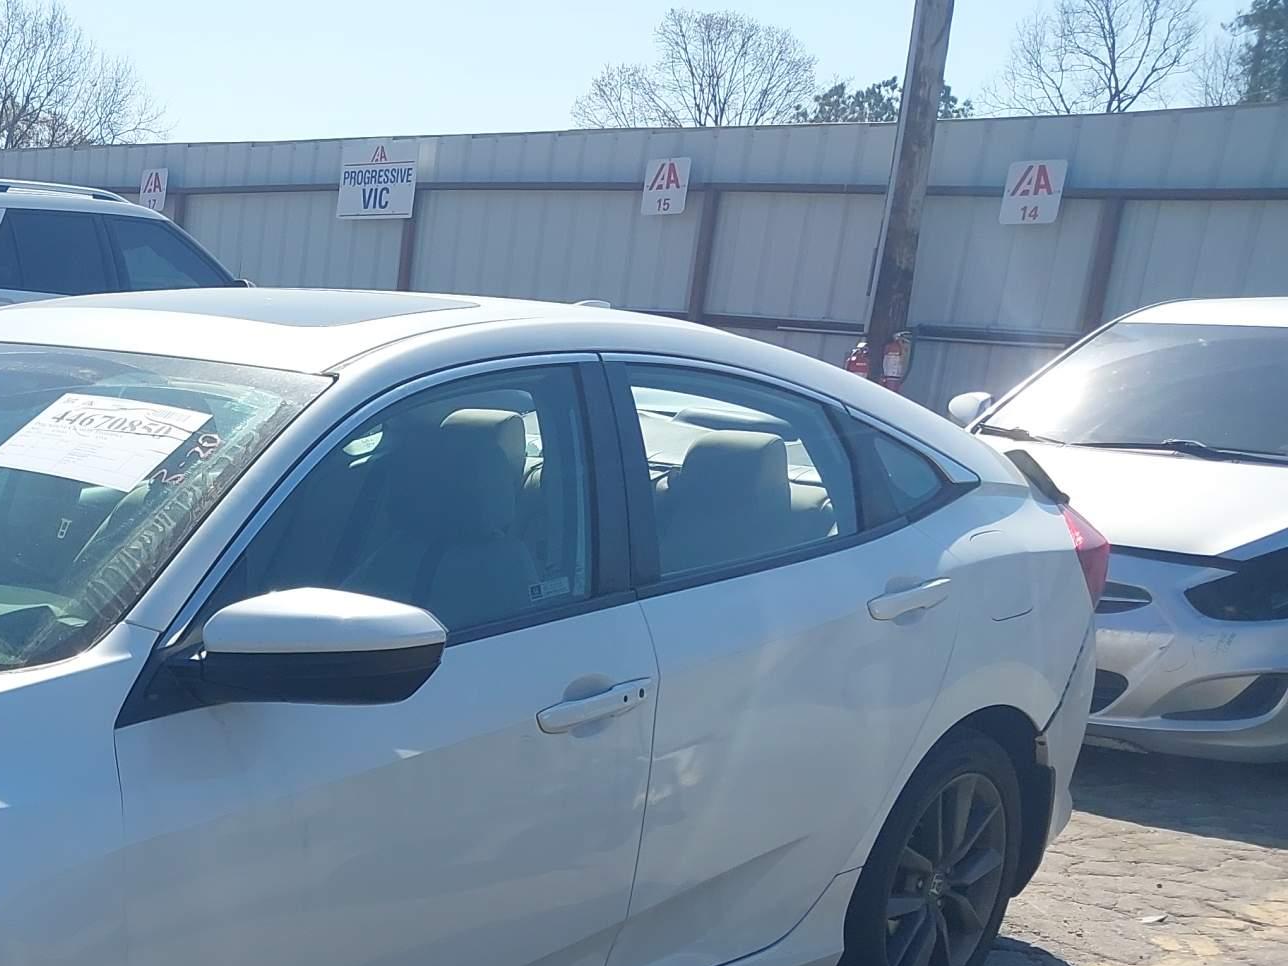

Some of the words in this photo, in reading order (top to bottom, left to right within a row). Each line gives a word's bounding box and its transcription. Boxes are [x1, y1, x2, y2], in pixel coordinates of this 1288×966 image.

[342, 167, 414, 186] PROGRESSIVE
[362, 187, 390, 210] VIC
[656, 198, 671, 212] 15
[1020, 205, 1040, 221] 14
